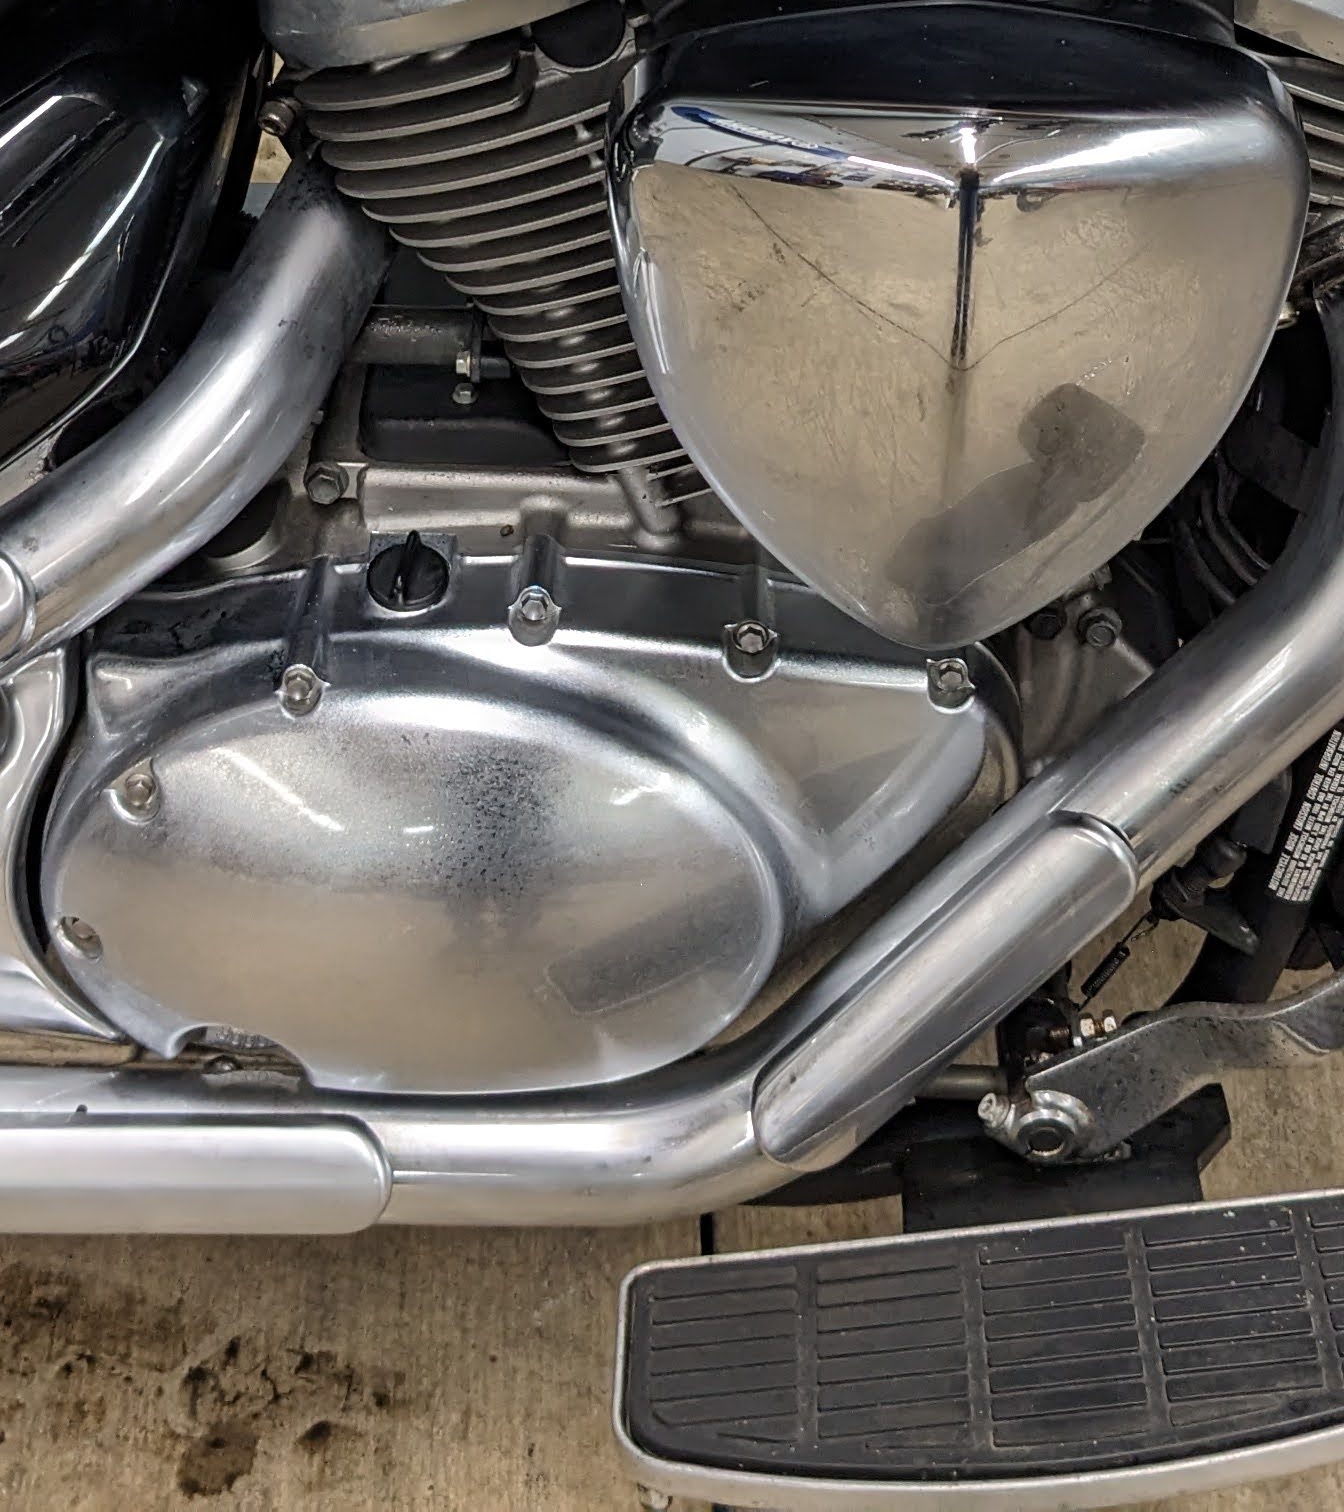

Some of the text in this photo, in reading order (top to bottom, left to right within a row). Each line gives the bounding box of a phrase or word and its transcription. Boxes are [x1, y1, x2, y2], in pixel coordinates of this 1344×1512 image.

[1267, 851, 1290, 891] MOTORCYCLE
[1291, 800, 1312, 831] EMISSION
[1305, 771, 1324, 800] CONTROL
[1317, 728, 1342, 771] INFORMATION
